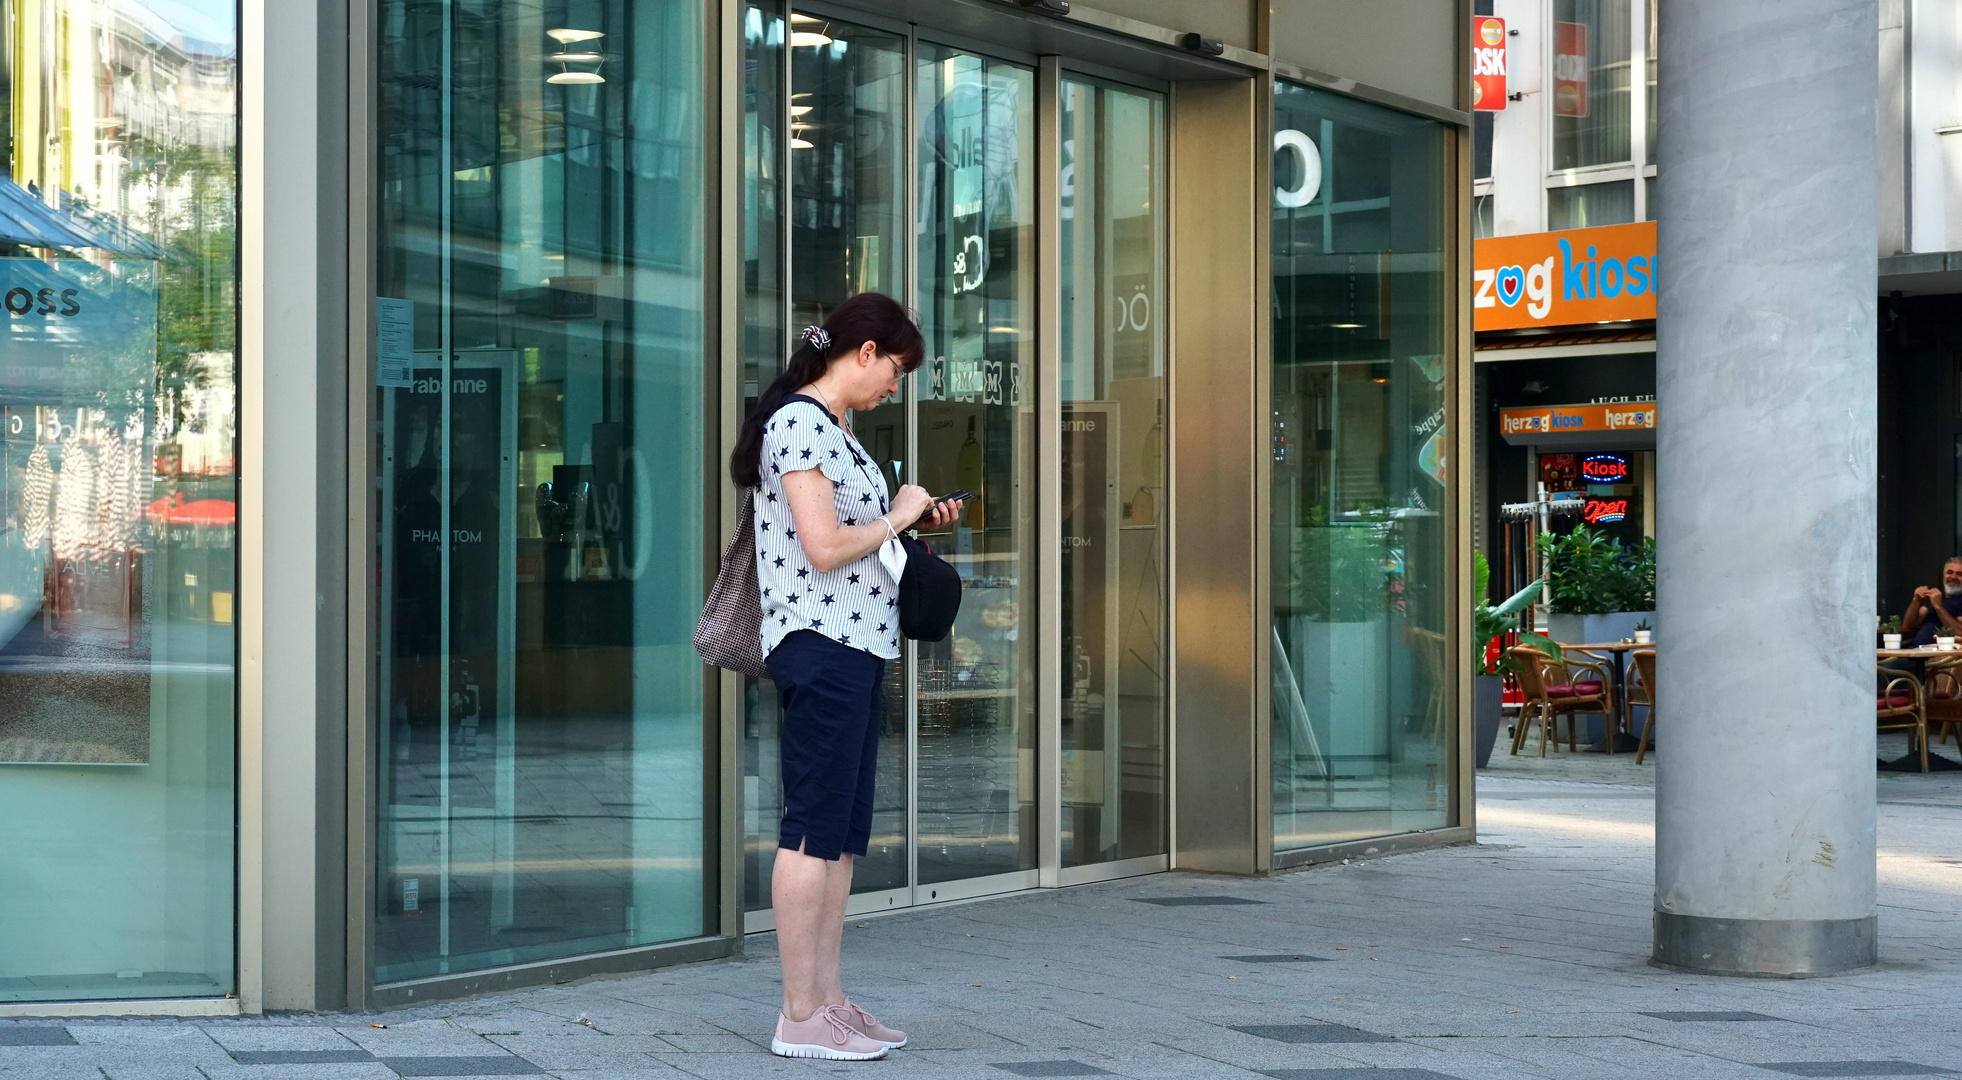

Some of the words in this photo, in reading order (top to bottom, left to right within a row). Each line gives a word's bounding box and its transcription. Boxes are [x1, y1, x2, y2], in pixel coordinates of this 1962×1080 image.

[1558, 237, 1657, 301] kios
[0, 287, 81, 317] OSS
[409, 376, 488, 394] rabnne
[1503, 414, 1550, 434] herzog
[1550, 409, 1585, 428] kiosk
[1605, 409, 1655, 430] herzog
[1583, 461, 1627, 475] Kiosk
[1584, 500, 1627, 524] Open
[412, 529, 482, 543] PHATOM
[62, 560, 110, 579] ALIVE
